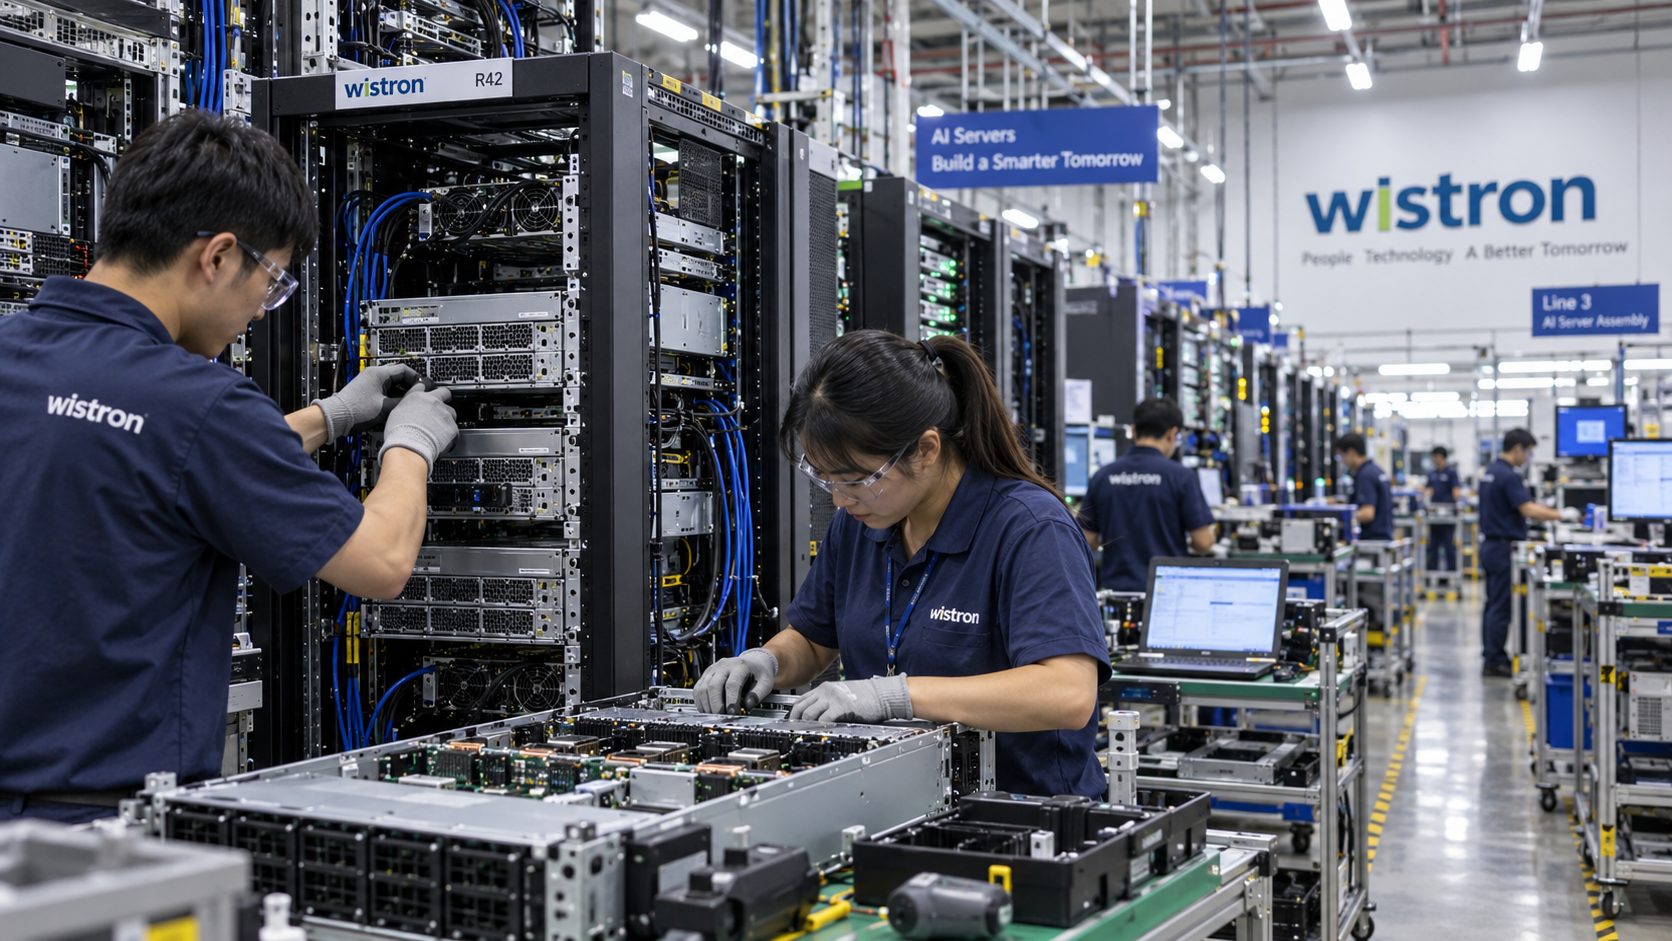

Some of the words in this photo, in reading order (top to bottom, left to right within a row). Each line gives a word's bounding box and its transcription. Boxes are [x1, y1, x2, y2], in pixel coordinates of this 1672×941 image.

[344, 77, 424, 98] wistron
[475, 72, 503, 87] R42
[931, 128, 949, 145] AI
[953, 126, 1016, 144] Servers
[931, 153, 974, 172] Build
[978, 157, 989, 171] a
[992, 153, 1059, 170] Smarter
[1060, 151, 1144, 168] Tomorrow
[1305, 172, 1596, 234] wistron
[1302, 251, 1353, 268] People
[1364, 247, 1453, 265] Technology
[1465, 245, 1478, 260] A
[1484, 243, 1534, 260] Better
[1540, 241, 1629, 258] Tomorrow
[1542, 294, 1577, 311] Line
[1580, 293, 1592, 311] 3
[1542, 315, 1556, 329] AI
[1558, 314, 1594, 329] Server
[1596, 312, 1650, 330] Assembly
[47, 393, 144, 435] wistron
[930, 605, 979, 624] wistron
